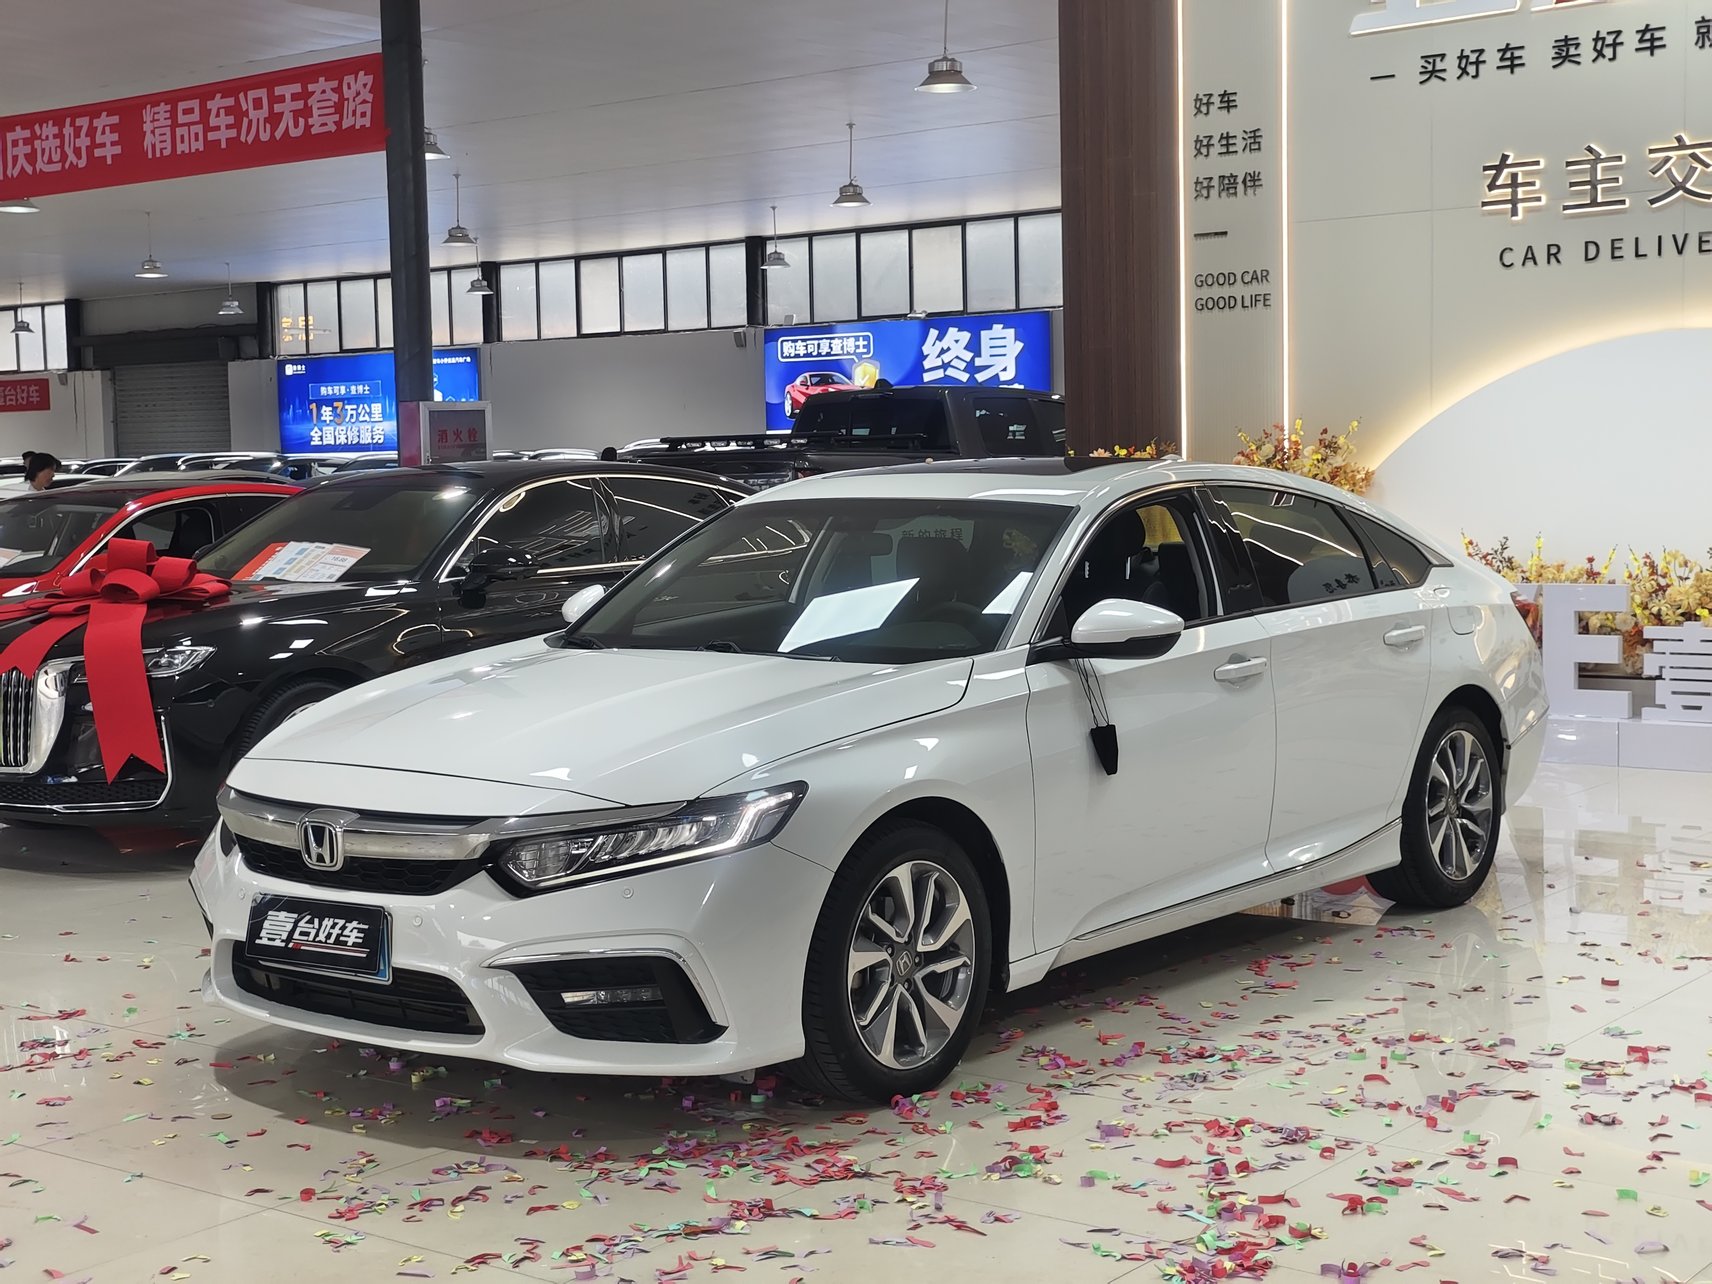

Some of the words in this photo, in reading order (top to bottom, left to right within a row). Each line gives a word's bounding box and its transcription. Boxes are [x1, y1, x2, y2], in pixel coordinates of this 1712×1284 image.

[1419, 42, 1526, 85] 买好车
[1551, 23, 1667, 69] 卖好车
[1193, 89, 1238, 117] 好车
[0, 112, 122, 180] 庆选好车
[142, 70, 375, 159] 精品车况无套路
[1193, 127, 1263, 158] 好生活
[1193, 170, 1264, 200] 好陪伴
[1480, 133, 1712, 220] 车主交
[1499, 243, 1562, 268] CAR
[1584, 231, 1712, 262] DELIVE
[1194, 271, 1237, 288] GOOD
[1240, 269, 1270, 286] CAR
[1194, 295, 1237, 311] GOOD
[1241, 293, 1272, 309] LIFE
[782, 336, 868, 358] 购车可享查博士
[921, 323, 1025, 384] 终身
[308, 401, 384, 425] 1年3万公里
[309, 426, 385, 446] 全国保修服务
[437, 428, 478, 444] 消火栓
[254, 910, 369, 947] 壹台好车
